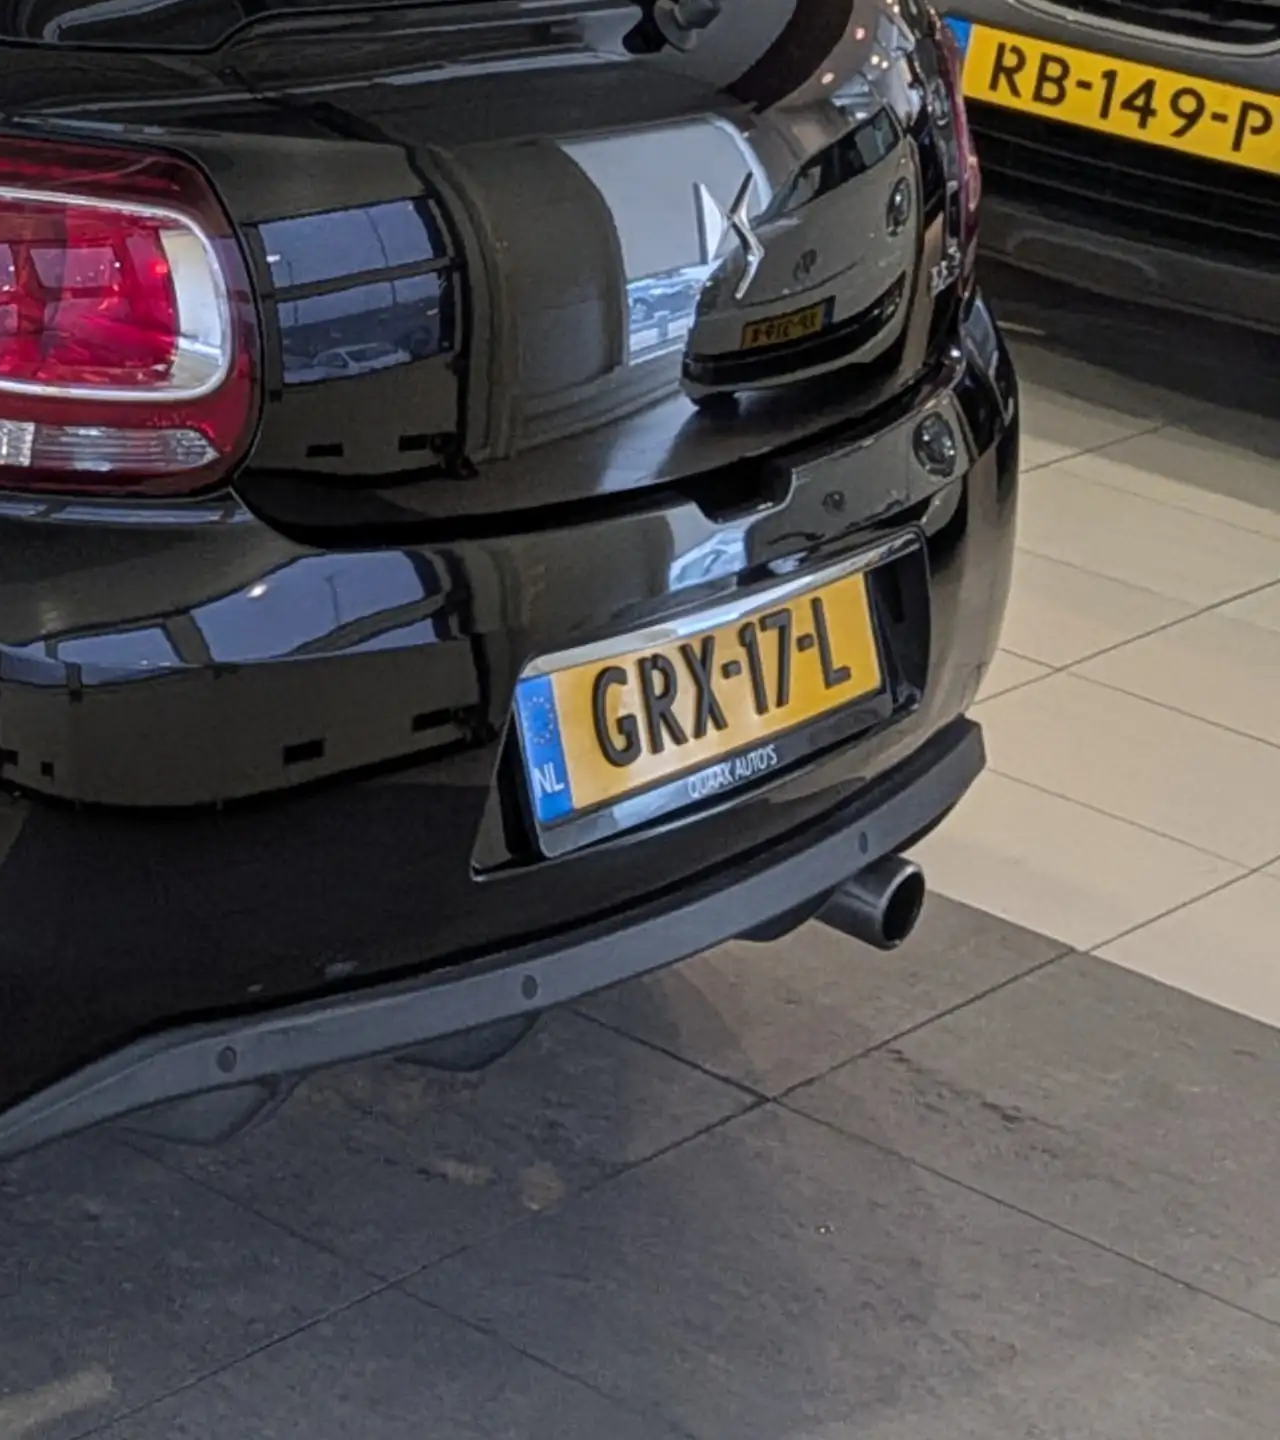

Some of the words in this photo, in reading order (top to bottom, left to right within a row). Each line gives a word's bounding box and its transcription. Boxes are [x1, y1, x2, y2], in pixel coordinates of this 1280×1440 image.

[988, 42, 1273, 151] RB-149-P
[592, 597, 852, 767] GRX-17-L
[535, 766, 564, 797] NL
